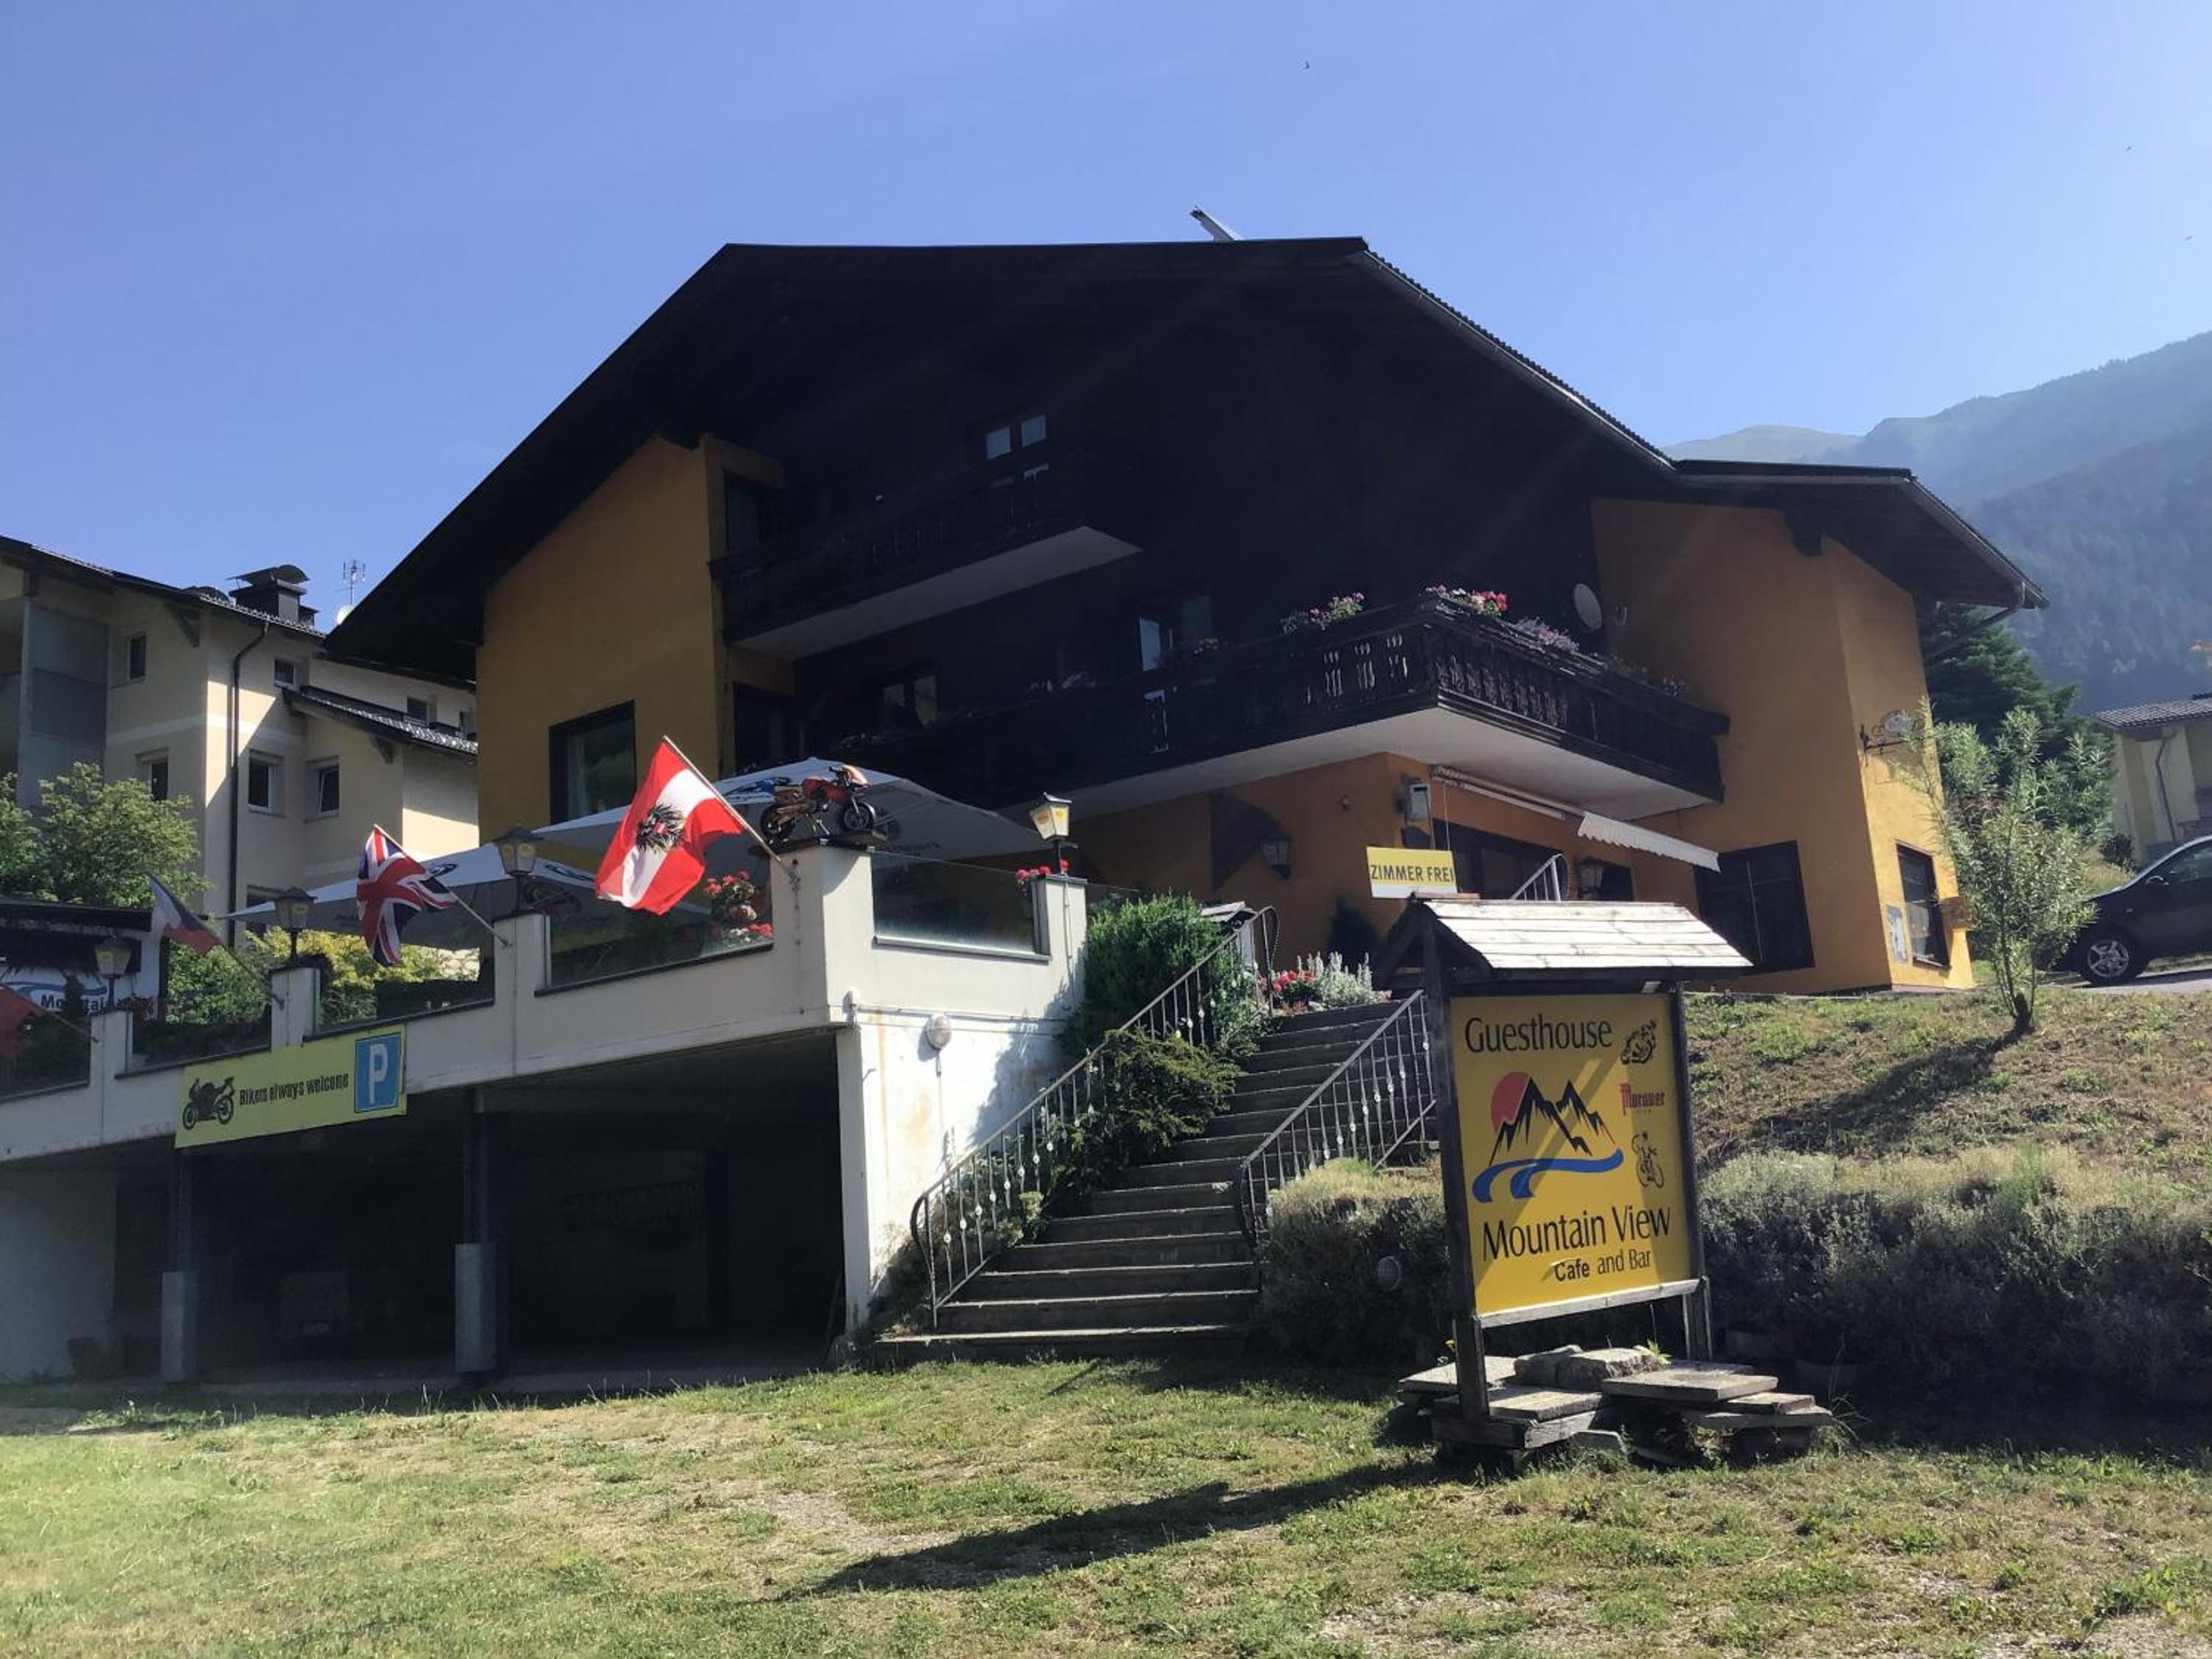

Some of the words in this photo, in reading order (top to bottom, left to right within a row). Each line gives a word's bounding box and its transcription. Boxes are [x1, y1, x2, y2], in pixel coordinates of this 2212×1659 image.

[1370, 864, 1424, 882] ZIMMER
[1426, 866, 1454, 883] FREI
[1464, 1015, 1613, 1053] Guesthouse
[269, 1082, 305, 1100] always
[306, 1073, 349, 1094] welcome
[369, 1043, 389, 1104] P
[1483, 1210, 1607, 1262] Mountain
[1611, 1205, 1672, 1242] View
[1554, 1258, 1590, 1282] Cafe
[1597, 1250, 1625, 1275] and
[1629, 1248, 1651, 1270] Bar
